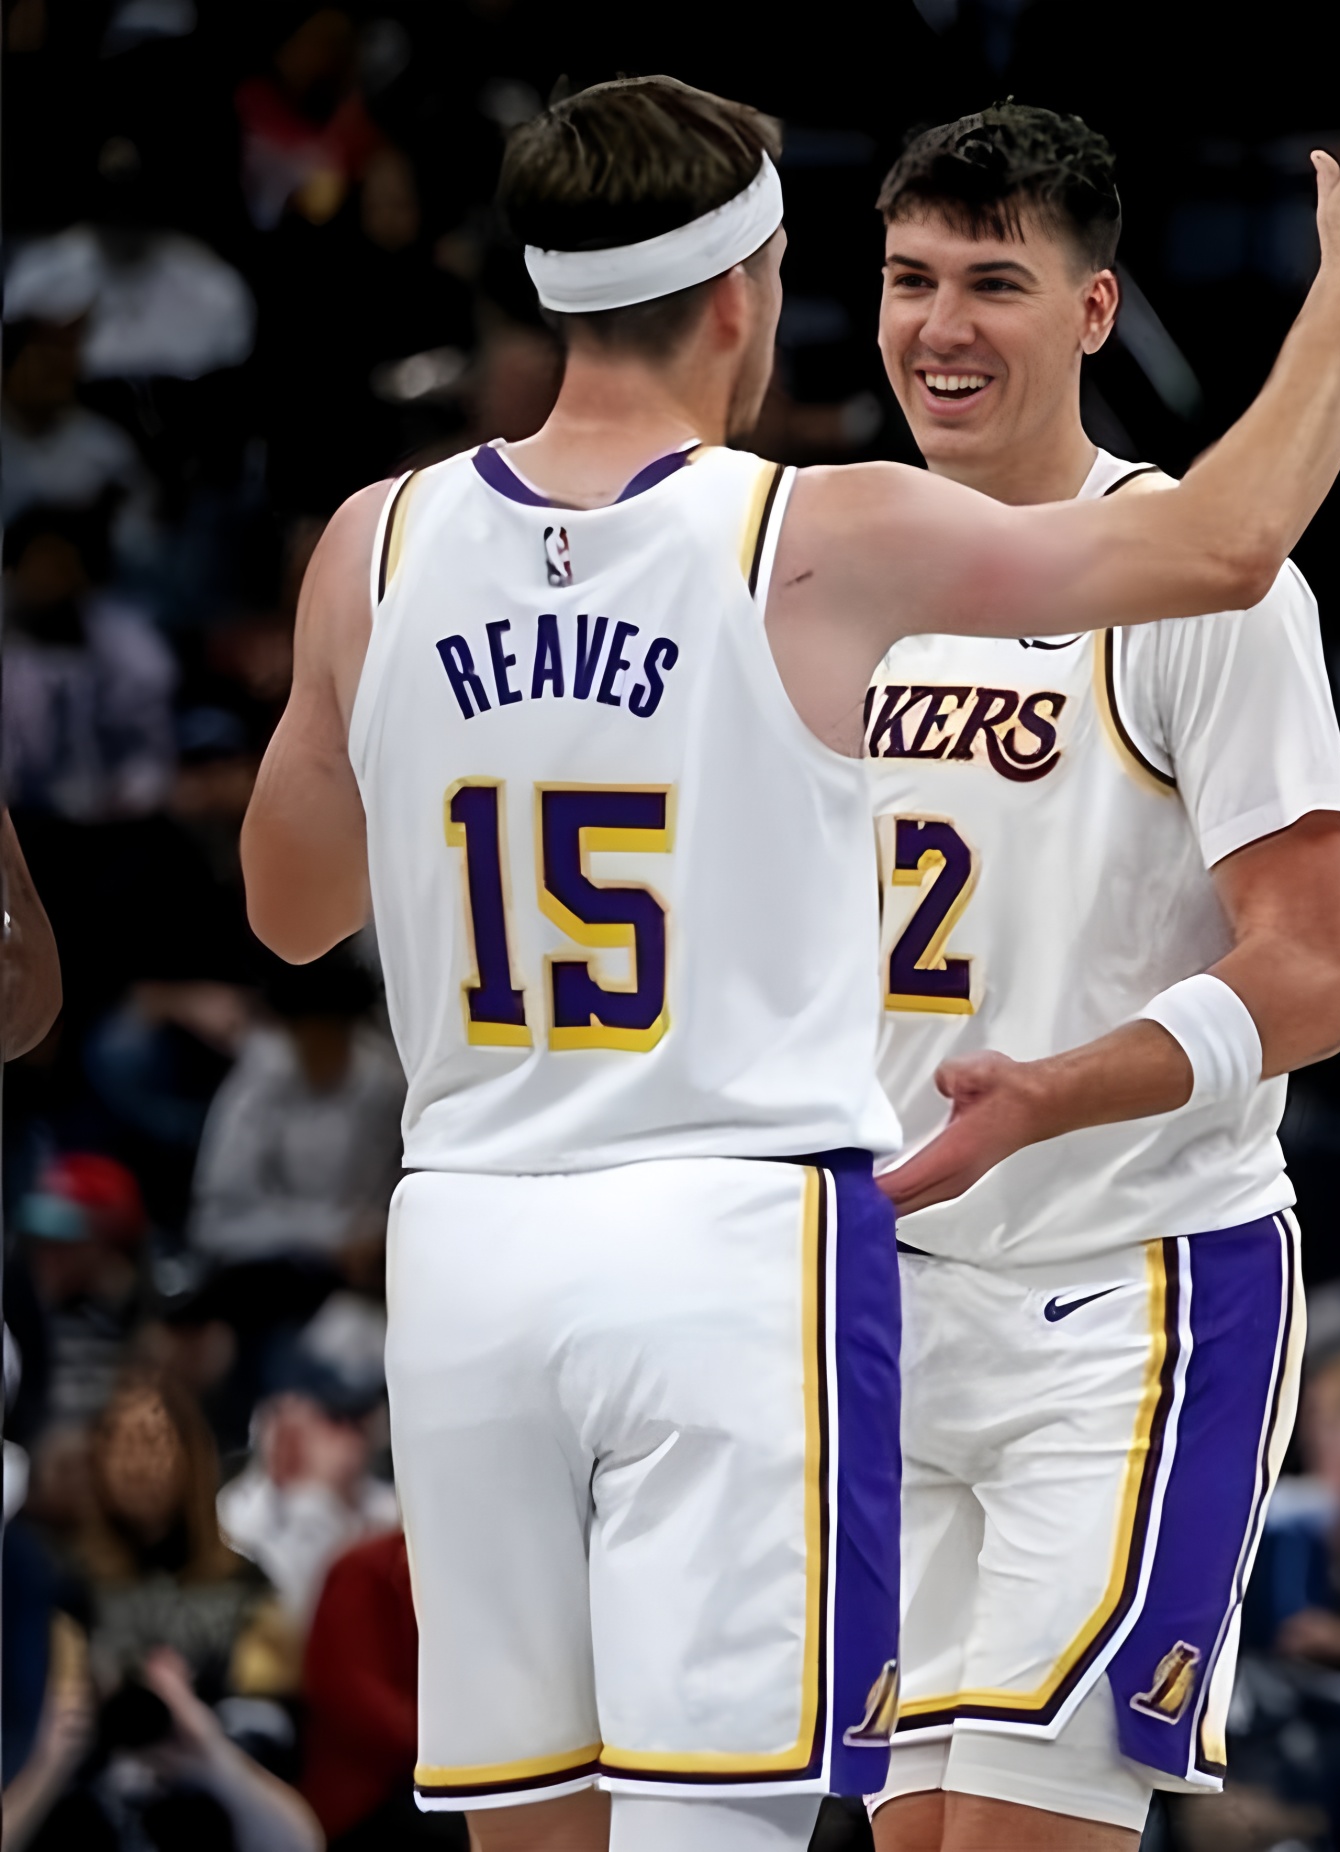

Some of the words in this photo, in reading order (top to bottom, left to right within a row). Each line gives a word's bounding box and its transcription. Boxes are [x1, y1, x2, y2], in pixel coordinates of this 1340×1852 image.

[436, 613, 680, 720] REAVES
[863, 685, 1068, 783] KERS
[443, 774, 678, 1052] 15
[880, 813, 982, 1015] 2
